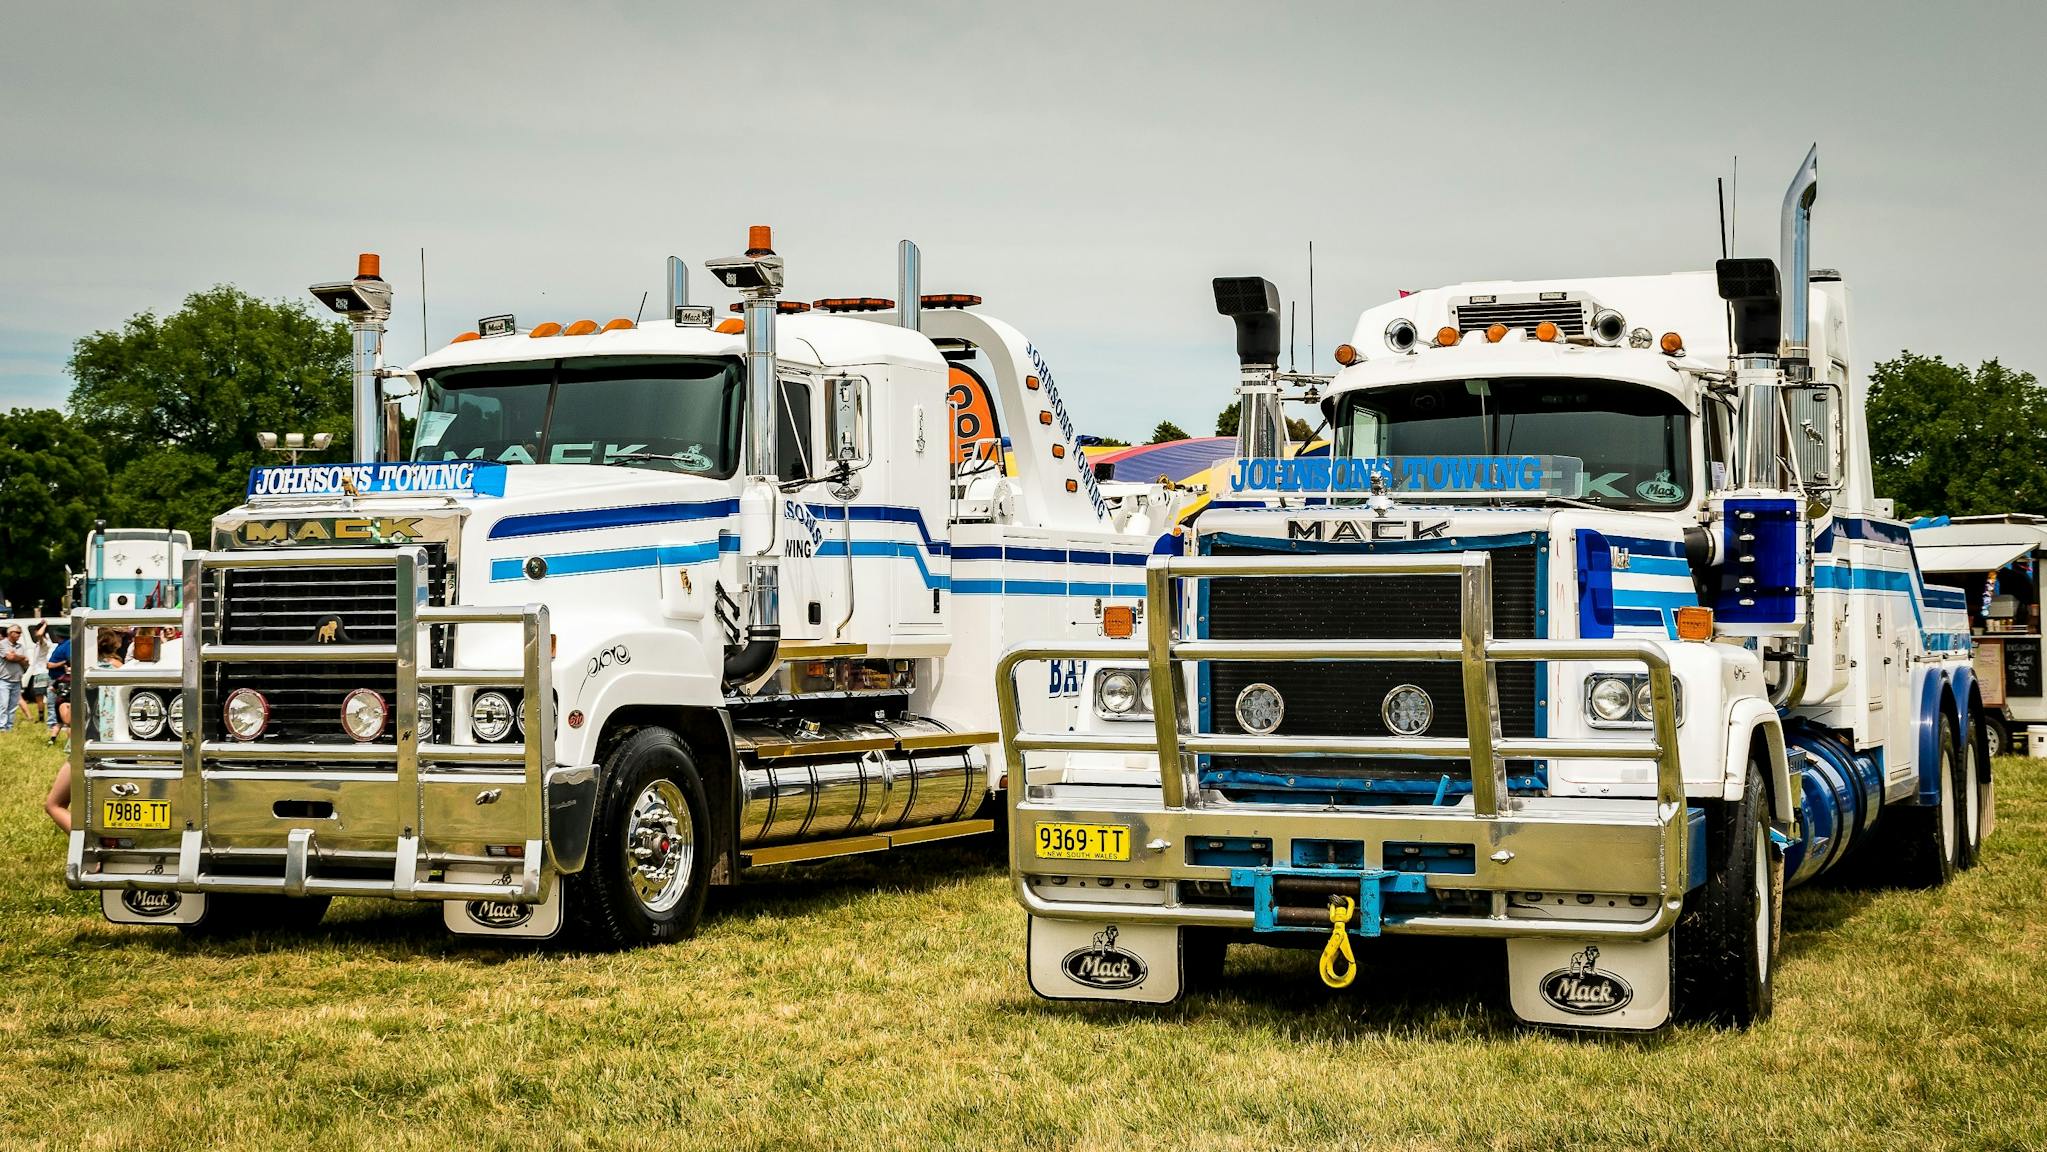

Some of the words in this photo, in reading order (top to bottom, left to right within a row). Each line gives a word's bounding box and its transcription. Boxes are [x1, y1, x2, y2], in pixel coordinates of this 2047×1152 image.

[1026, 340, 1074, 443] JOHNSONS
[1072, 435, 1106, 523] TOWING
[443, 443, 648, 464] MACK
[255, 465, 373, 495] JOHNSONS
[379, 462, 474, 492] TOWING
[1230, 457, 1392, 492] JOHNSONS
[1402, 456, 1543, 491] TOWING
[1645, 483, 1677, 498] Mack
[246, 517, 423, 541] MACK
[784, 500, 824, 546] SONS
[1287, 520, 1450, 542] MACK
[1048, 660, 1087, 698] BA
[1094, 852, 1118, 860] WALES
[132, 889, 171, 907] Mack
[478, 900, 520, 918] Mack
[1077, 955, 1134, 978] Mack
[1553, 978, 1615, 1004] Mack
